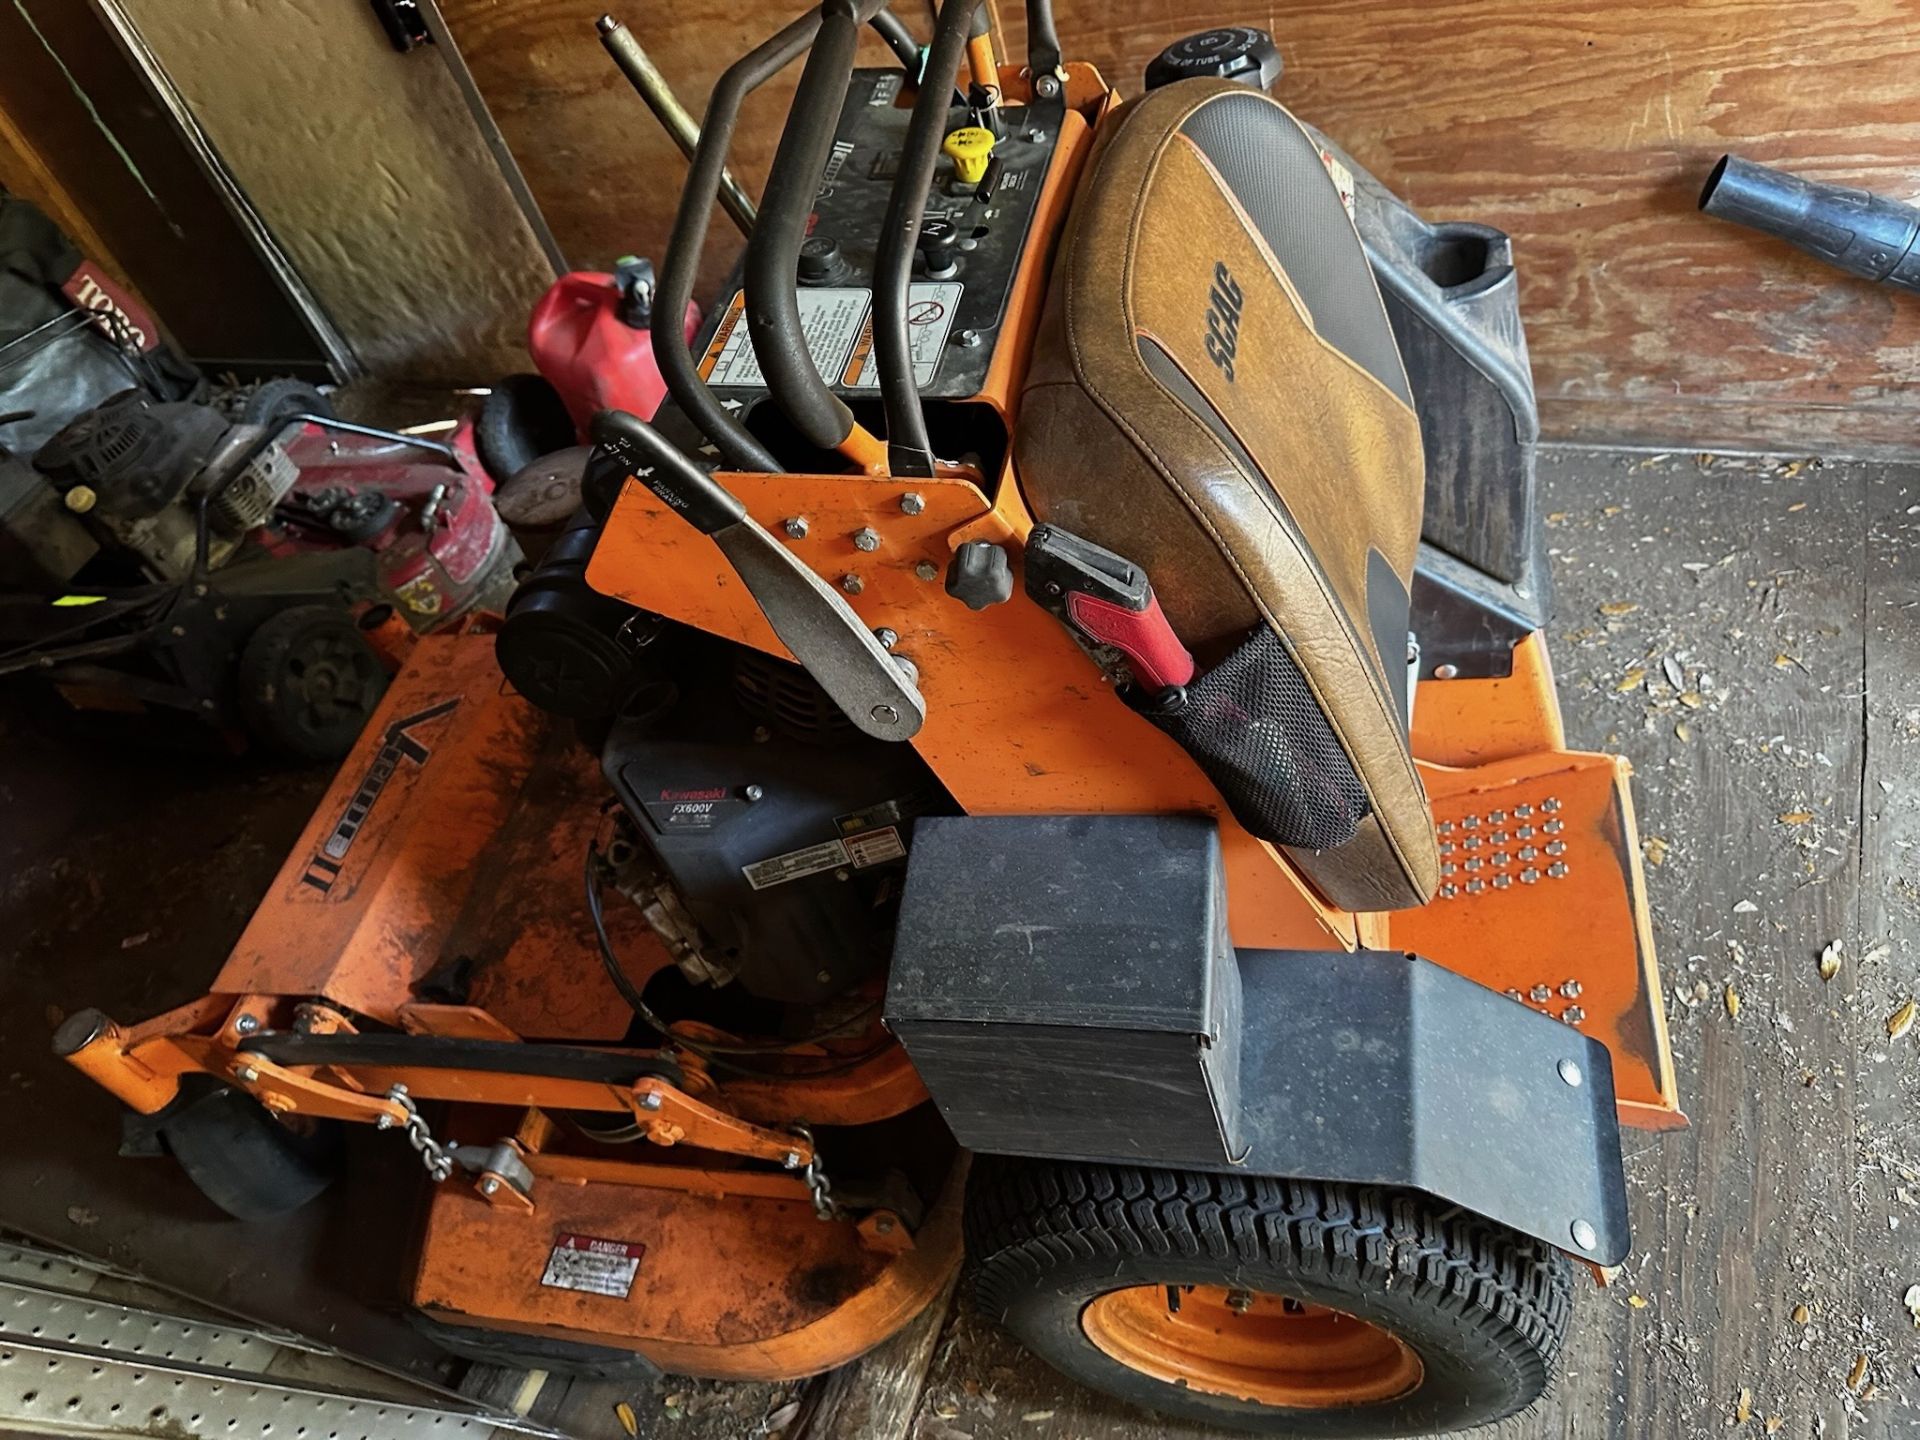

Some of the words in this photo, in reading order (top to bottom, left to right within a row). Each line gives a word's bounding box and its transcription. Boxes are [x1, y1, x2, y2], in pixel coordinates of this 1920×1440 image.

[1195, 55, 1220, 65] TUBE
[714, 308, 741, 343] WARNING
[1204, 261, 1244, 382] SCAG
[653, 480, 689, 508] PARKING
[653, 486, 678, 507] BRAKE
[661, 786, 726, 801] Kawasaki
[672, 803, 713, 813] FX600V
[589, 1240, 628, 1255] DANGER
